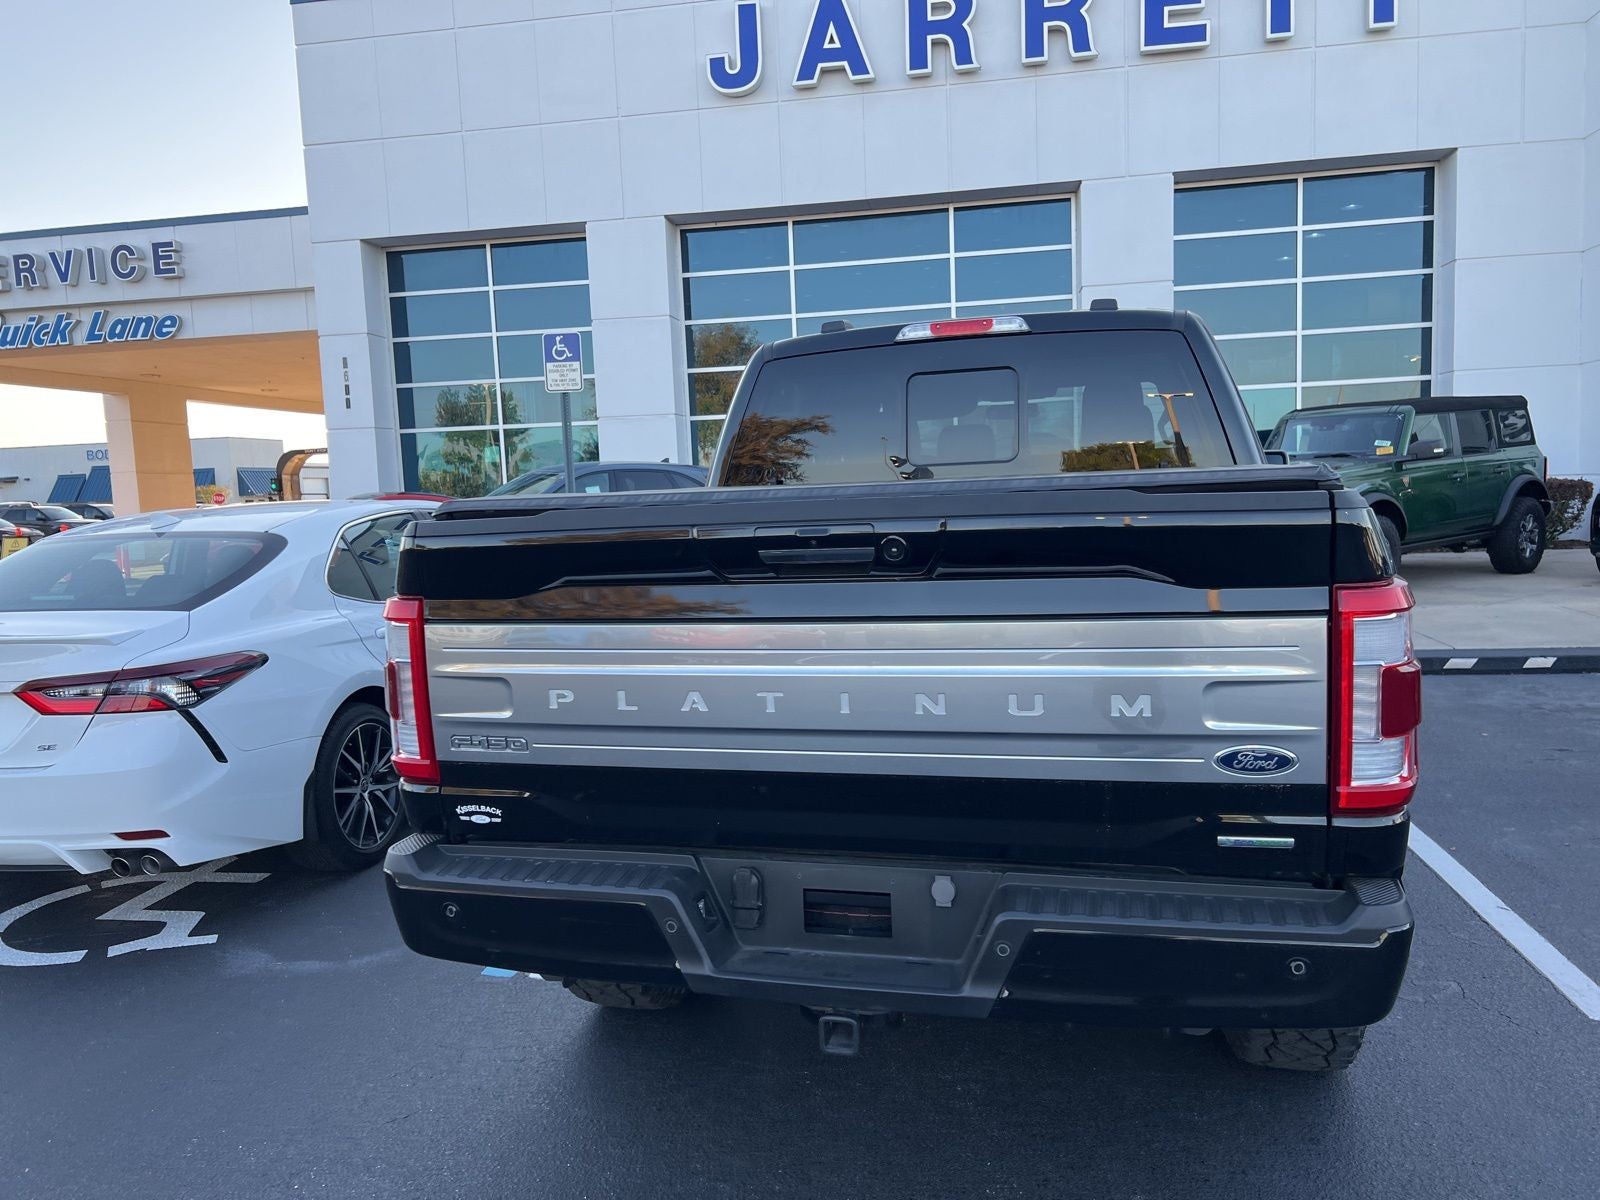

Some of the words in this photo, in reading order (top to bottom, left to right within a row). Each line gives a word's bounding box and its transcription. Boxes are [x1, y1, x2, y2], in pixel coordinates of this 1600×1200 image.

[0, 311, 81, 350] uick
[84, 309, 182, 344] Lane
[549, 689, 1152, 717] PLATINUM
[450, 735, 529, 753] F-150
[1233, 750, 1279, 769] Ford
[456, 805, 502, 816] KISSELBACK
